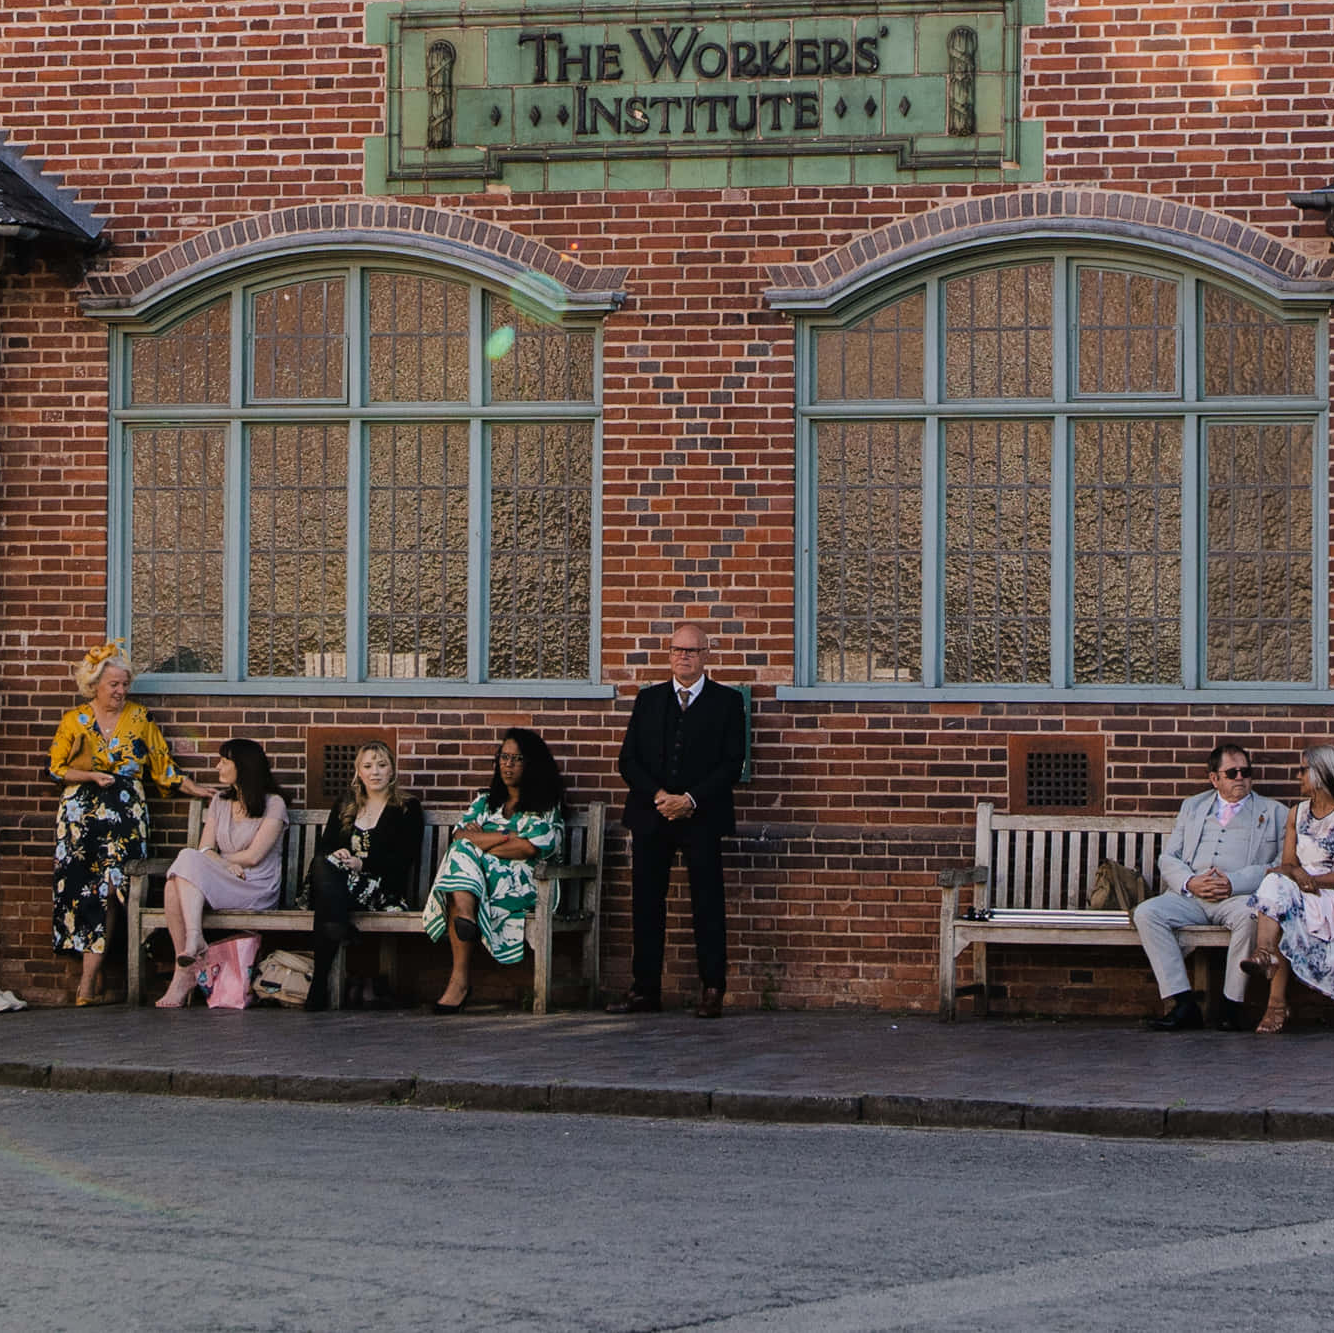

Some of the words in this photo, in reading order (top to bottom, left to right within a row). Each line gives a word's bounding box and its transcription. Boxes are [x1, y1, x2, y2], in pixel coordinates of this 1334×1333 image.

[518, 32, 624, 83] THE
[628, 25, 889, 78] WORKERS'
[575, 85, 820, 135] INSTITUTE
